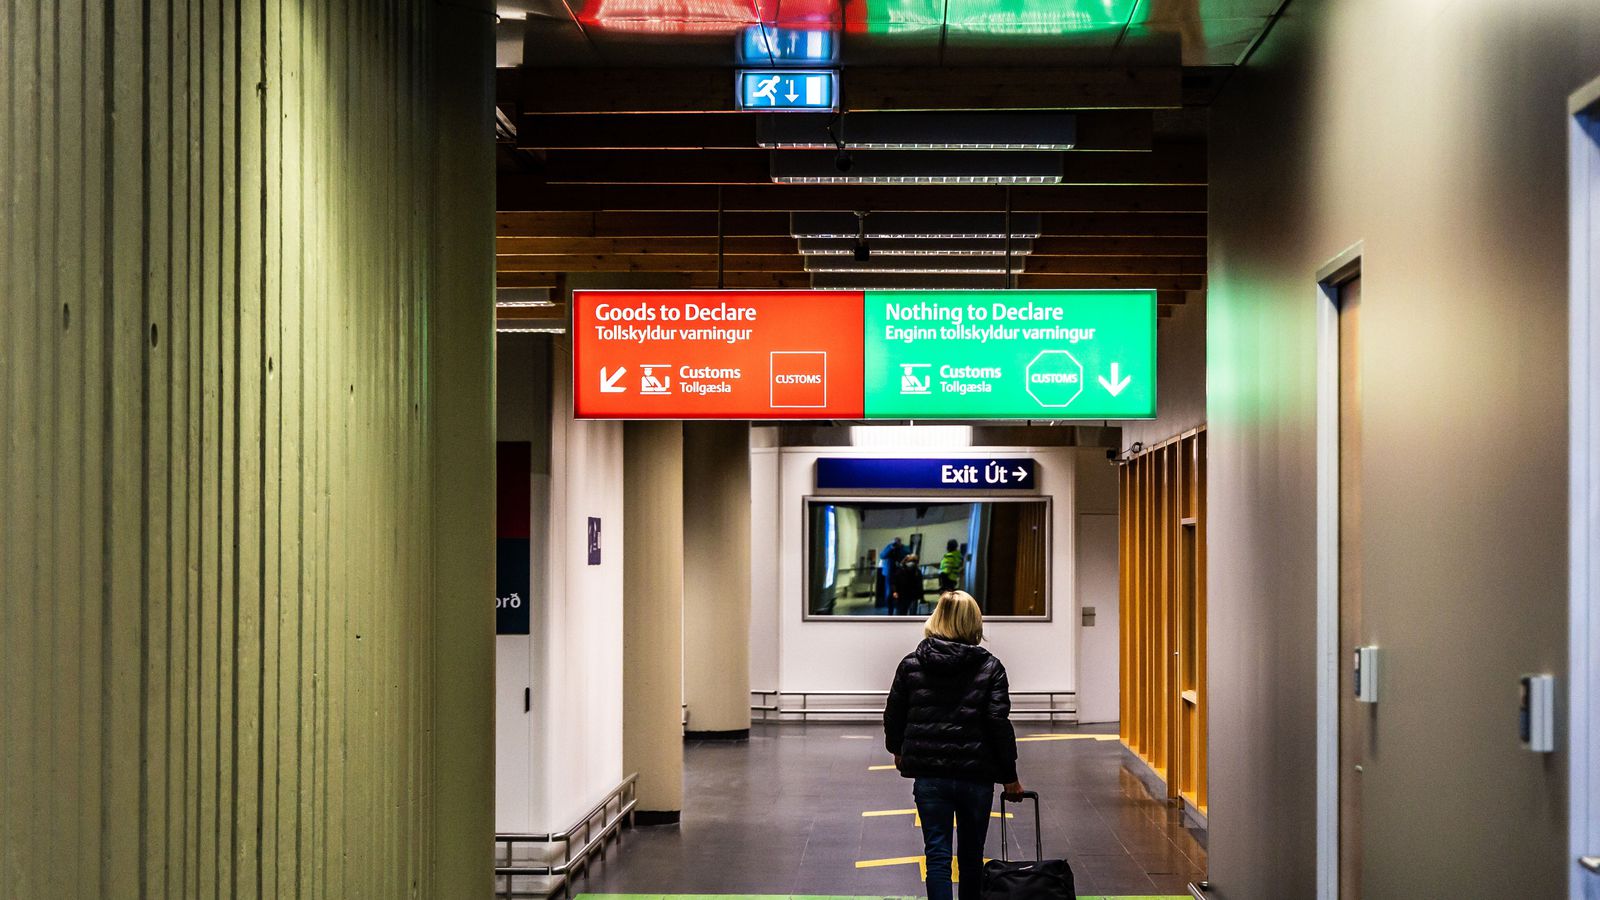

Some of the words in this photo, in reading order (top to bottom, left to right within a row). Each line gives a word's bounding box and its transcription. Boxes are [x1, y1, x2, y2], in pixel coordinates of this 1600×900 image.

[595, 303, 656, 321] Goods
[660, 304, 681, 321] to
[685, 303, 757, 321] Declare
[885, 302, 963, 325] Nothing
[967, 304, 988, 321] to
[992, 302, 1064, 321] Declare
[595, 325, 677, 344] Tollskyldur
[679, 326, 752, 344] varningur
[885, 325, 937, 344] Enginn
[940, 324, 1020, 344] tollskyldur
[1022, 326, 1096, 344] varningur
[679, 365, 741, 379] Customs
[775, 374, 821, 384] CUSTOMS
[939, 364, 1002, 379] Customs
[1031, 373, 1078, 384] CUSTOMS
[679, 382, 732, 396] Tollgæsla
[940, 381, 992, 396] Tollgæsla
[941, 465, 978, 483] Exit
[984, 461, 1008, 483] Út
